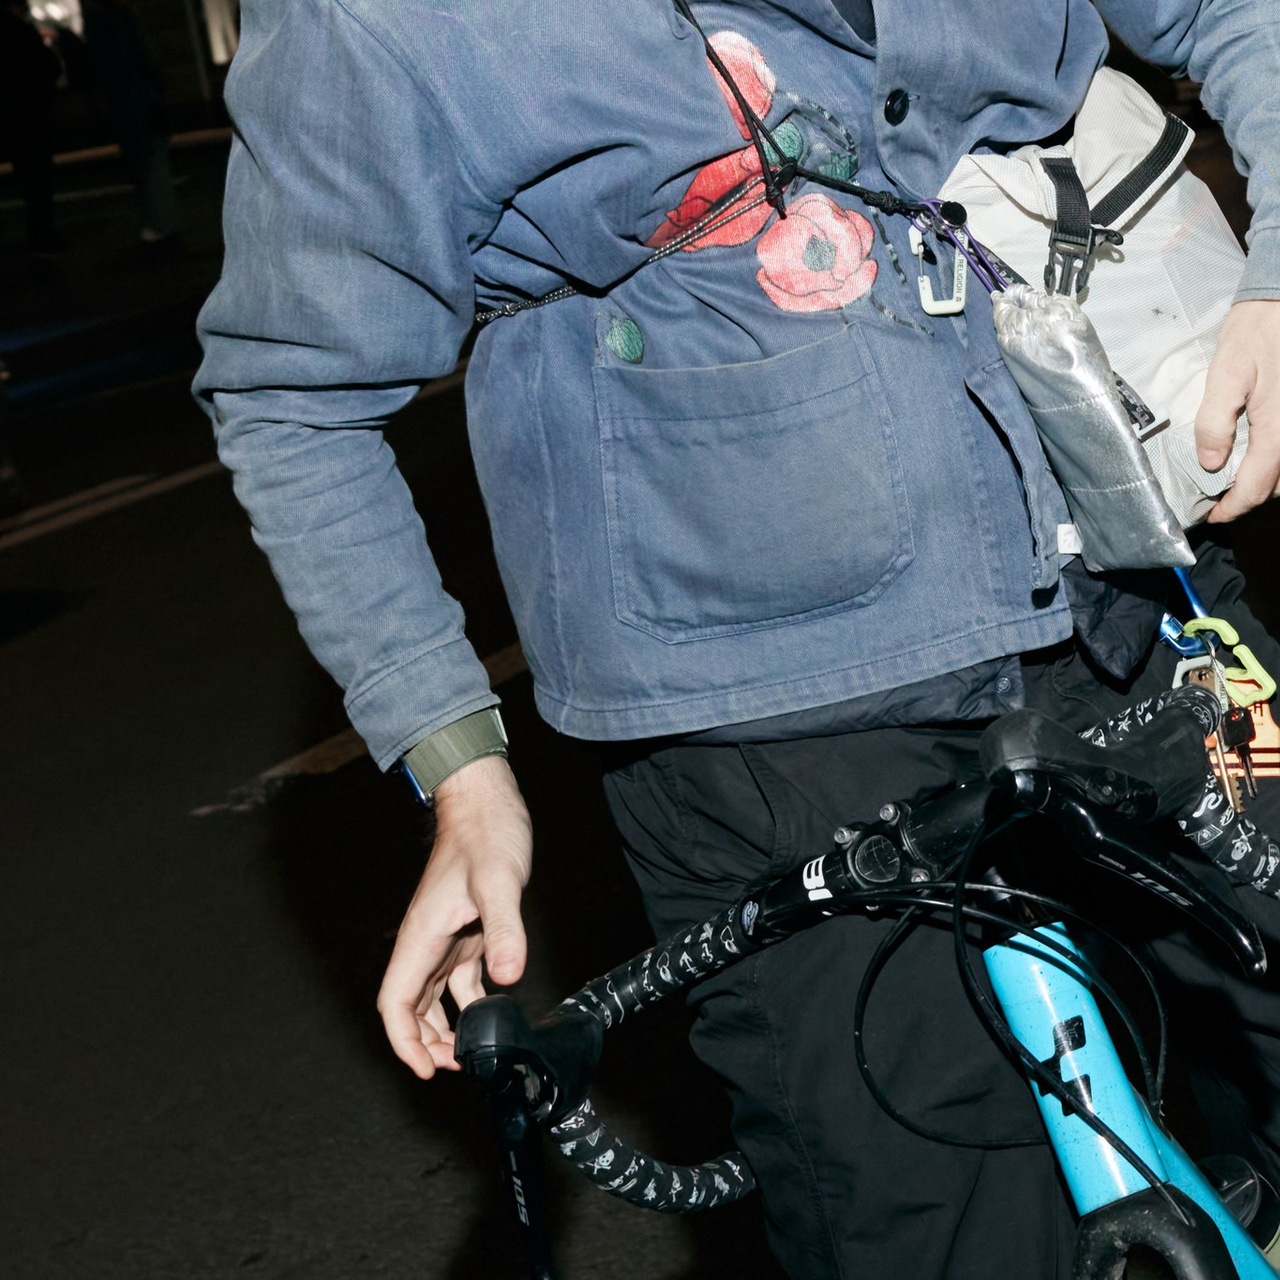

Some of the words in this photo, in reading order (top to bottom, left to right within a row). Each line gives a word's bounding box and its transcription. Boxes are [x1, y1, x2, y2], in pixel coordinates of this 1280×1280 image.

[955, 258, 966, 294] RELIGION
[1130, 872, 1194, 906] 105
[512, 1176, 530, 1226] 105
